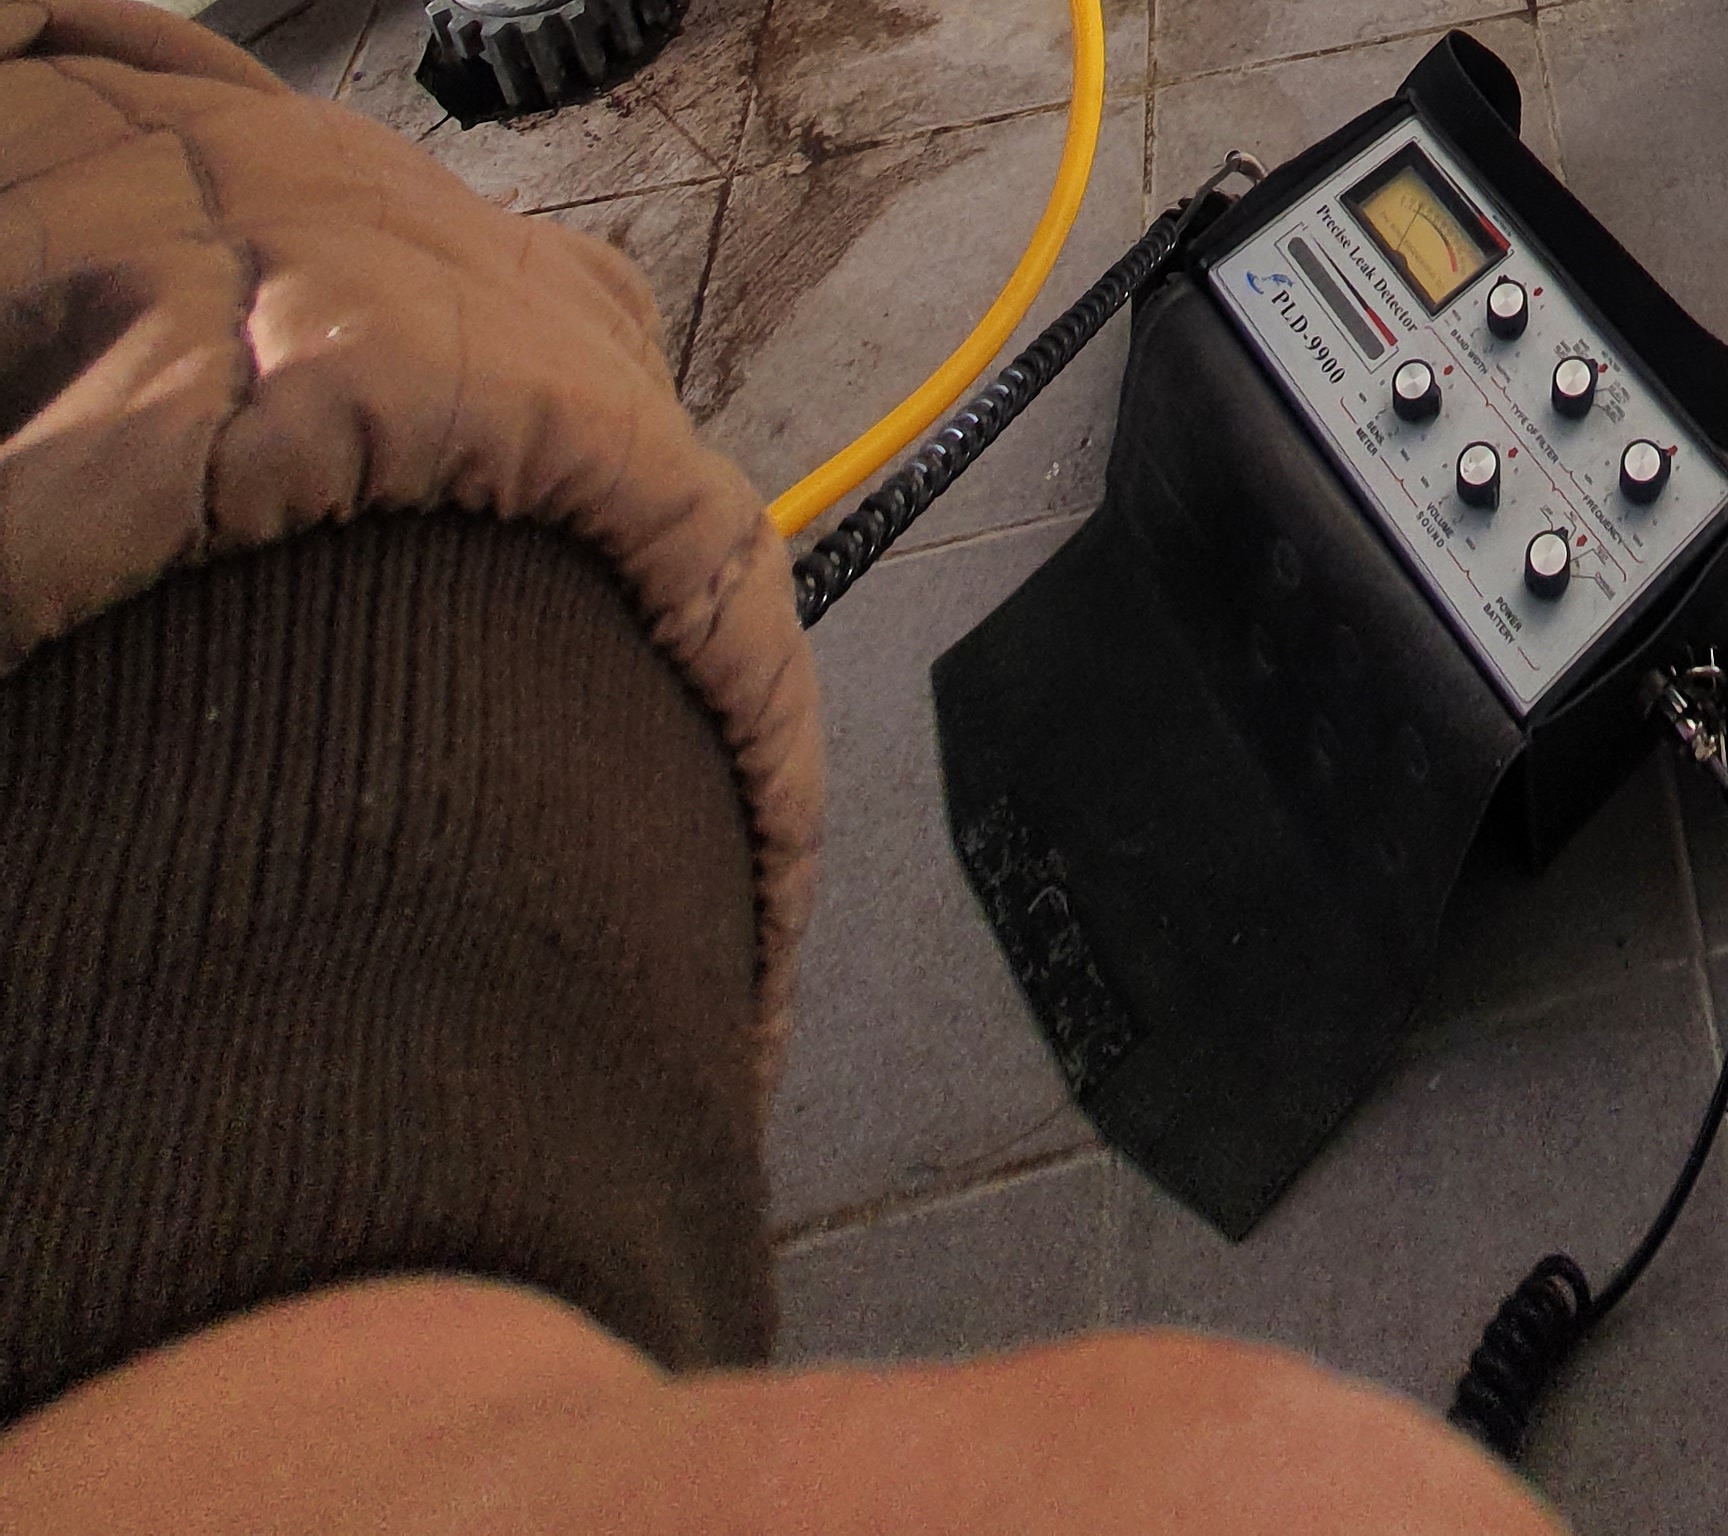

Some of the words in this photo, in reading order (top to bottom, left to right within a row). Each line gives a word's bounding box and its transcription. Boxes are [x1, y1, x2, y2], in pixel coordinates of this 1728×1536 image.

[1316, 205, 1352, 247] Precise
[1348, 247, 1377, 280] Leak
[1372, 278, 1419, 334] Detector
[1270, 289, 1347, 385] PLD-9900
[1451, 329, 1469, 351] BAND
[1467, 350, 1488, 375] WIDTH
[1355, 428, 1379, 456] METER
[1510, 403, 1529, 425] TYPE
[1525, 423, 1538, 436] OF
[1534, 433, 1559, 464] FILTER
[1416, 511, 1445, 548] SOUND
[1426, 503, 1455, 538] VOLUME
[1582, 495, 1625, 545] FREQUENCY
[1482, 603, 1516, 644] BATTERY
[1495, 597, 1523, 632] POWER
